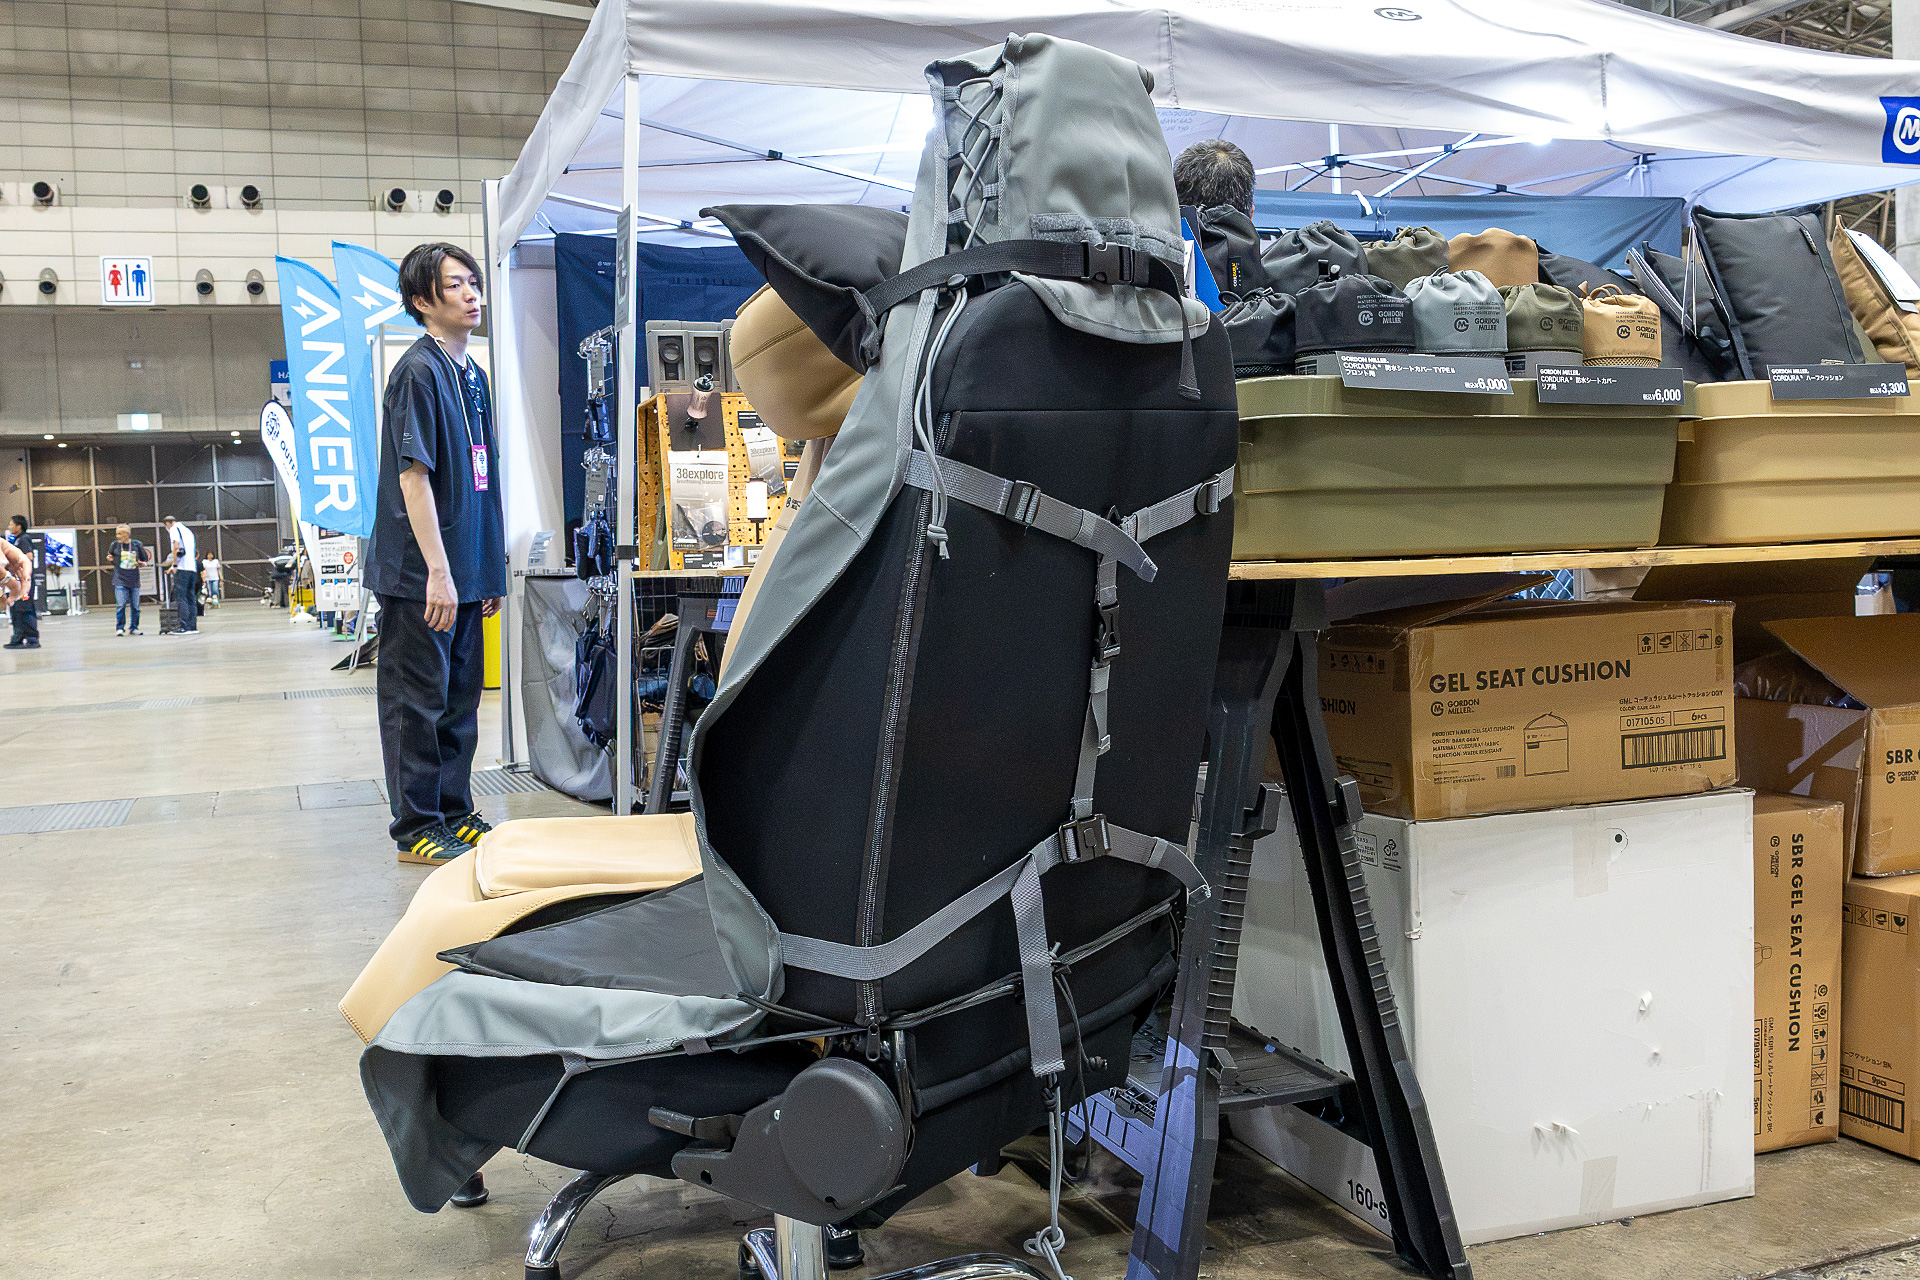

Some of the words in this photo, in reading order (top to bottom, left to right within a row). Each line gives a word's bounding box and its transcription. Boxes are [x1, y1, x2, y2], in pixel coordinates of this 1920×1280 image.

[1378, 310, 1404, 318] GORDON
[1474, 317, 1500, 325] GORDON
[1635, 325, 1658, 334] GORDON
[291, 285, 357, 516] ANKER
[676, 467, 724, 481] 38explore
[1429, 673, 1470, 694] GEL
[1476, 667, 1526, 691] SEAT
[1531, 659, 1631, 686] CUSHION
[1447, 698, 1480, 708] GORDON
[1885, 748, 1914, 765] SBR
[1791, 833, 1804, 869] SBR
[1790, 874, 1804, 909] GEL
[1790, 913, 1803, 957] SEAT
[1788, 964, 1802, 1052] CUSHION
